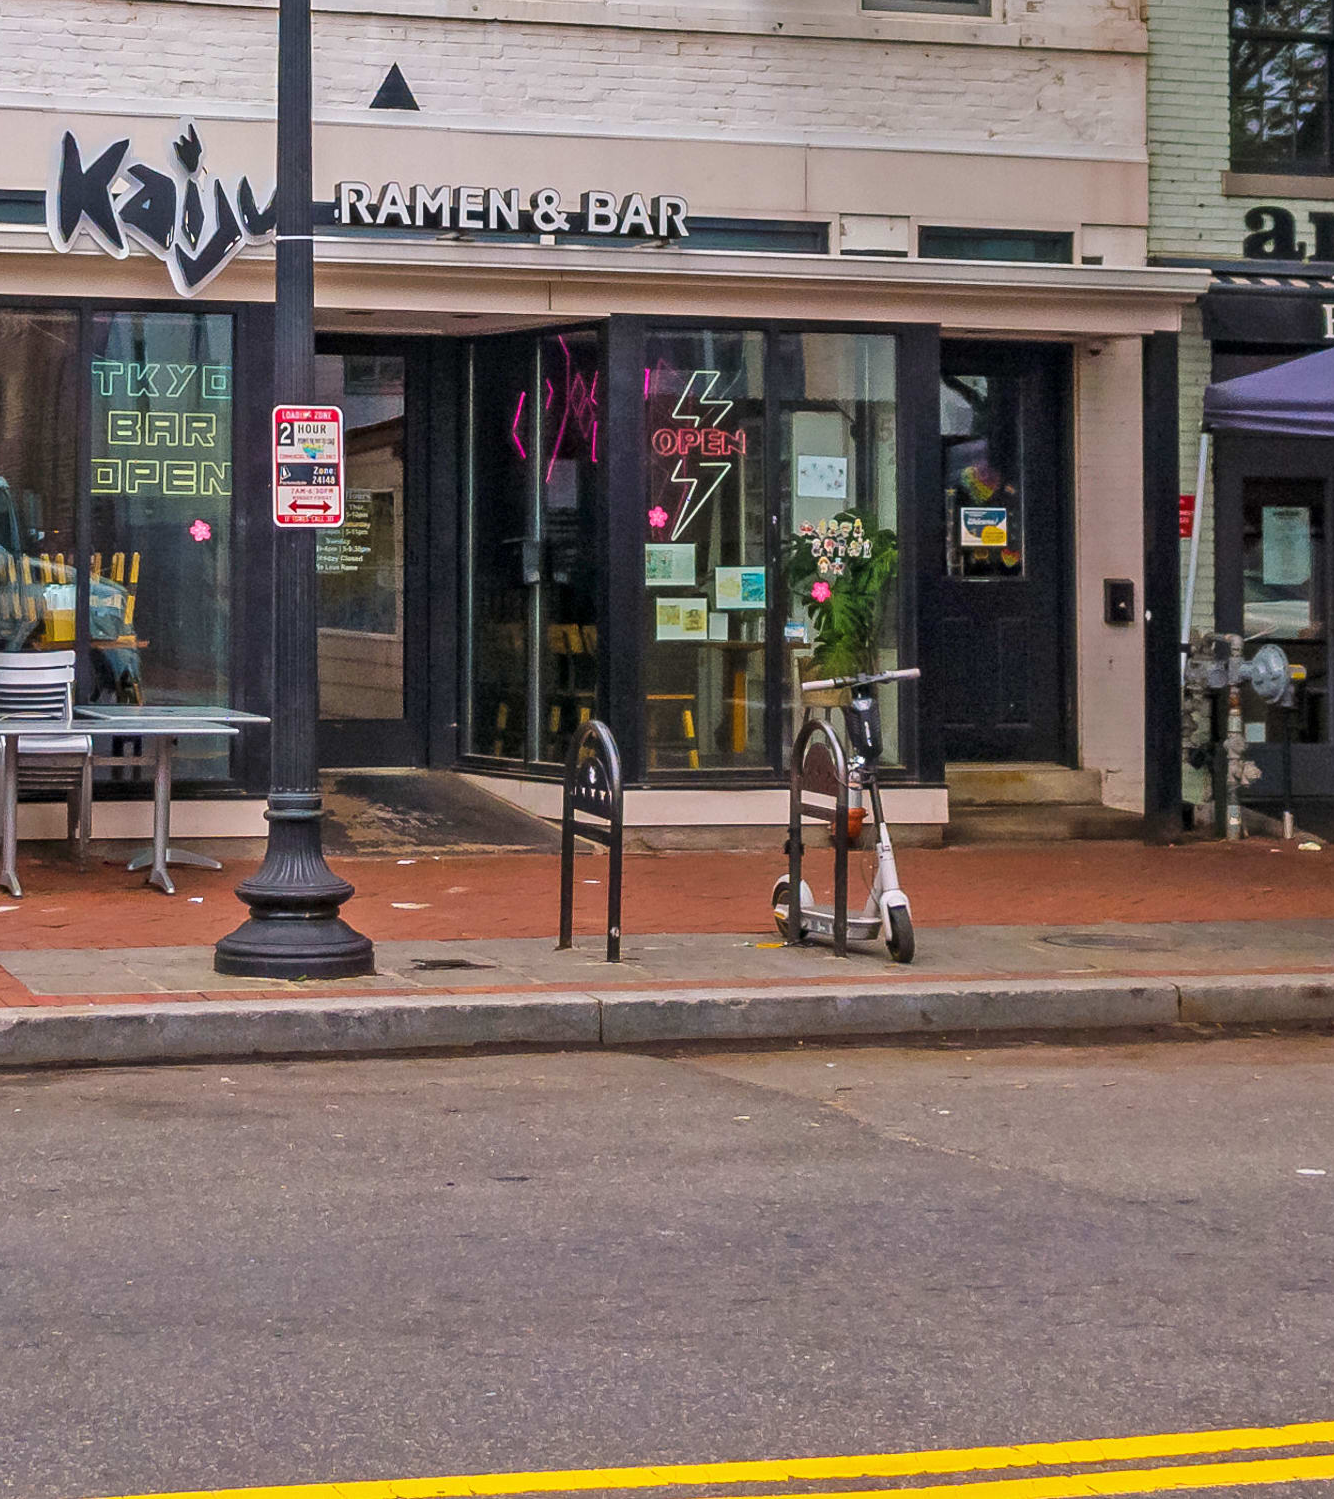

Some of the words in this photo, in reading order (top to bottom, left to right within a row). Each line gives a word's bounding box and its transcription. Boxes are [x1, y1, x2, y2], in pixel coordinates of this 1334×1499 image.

[336, 181, 519, 231] RAMEN
[531, 188, 569, 232] &
[581, 190, 690, 237] BAR
[91, 361, 234, 399] TKYO
[108, 410, 217, 447] BAR
[297, 423, 327, 434] HOUR
[314, 411, 332, 420] ZONE
[279, 421, 292, 444] 2
[652, 428, 747, 455] OPEN
[90, 458, 233, 495] OPEN
